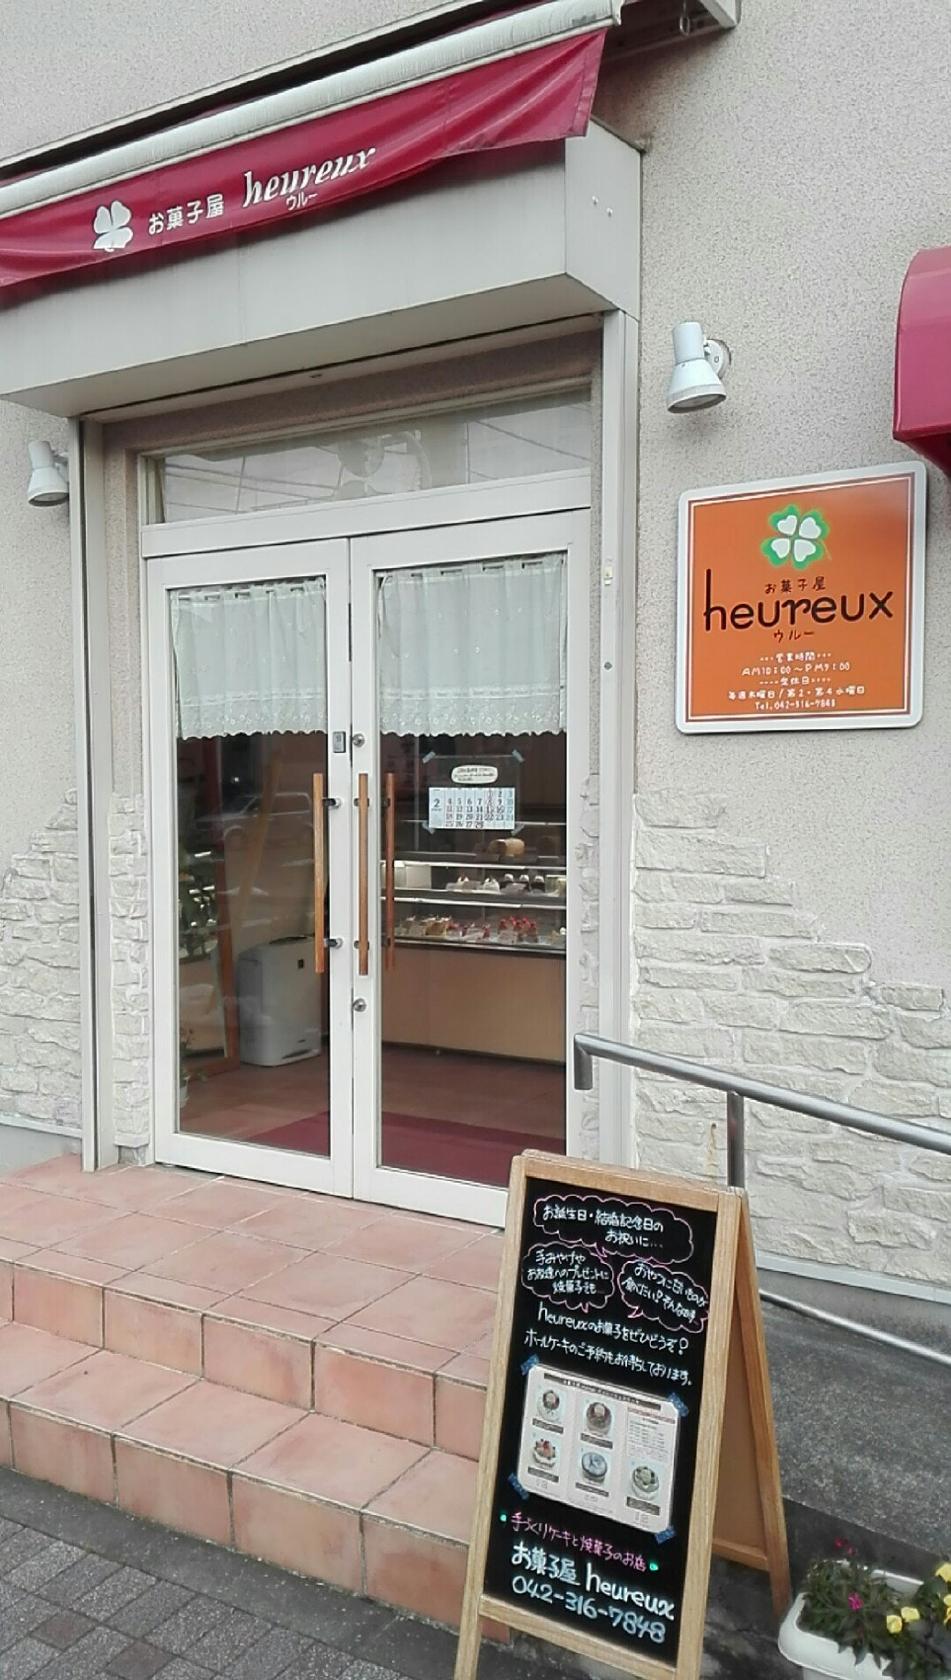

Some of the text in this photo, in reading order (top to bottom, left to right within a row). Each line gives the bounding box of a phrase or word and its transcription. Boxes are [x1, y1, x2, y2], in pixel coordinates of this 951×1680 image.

[148, 147, 376, 235] お菓子屋 heureux
[285, 191, 318, 211] ウルー
[703, 568, 894, 631] heureux
[764, 576, 826, 594] お菓子屋
[773, 629, 815, 643] ウルー
[511, 1540, 675, 1620] お菓子屋 heureux
[511, 1575, 667, 1643] 042-316-7848
